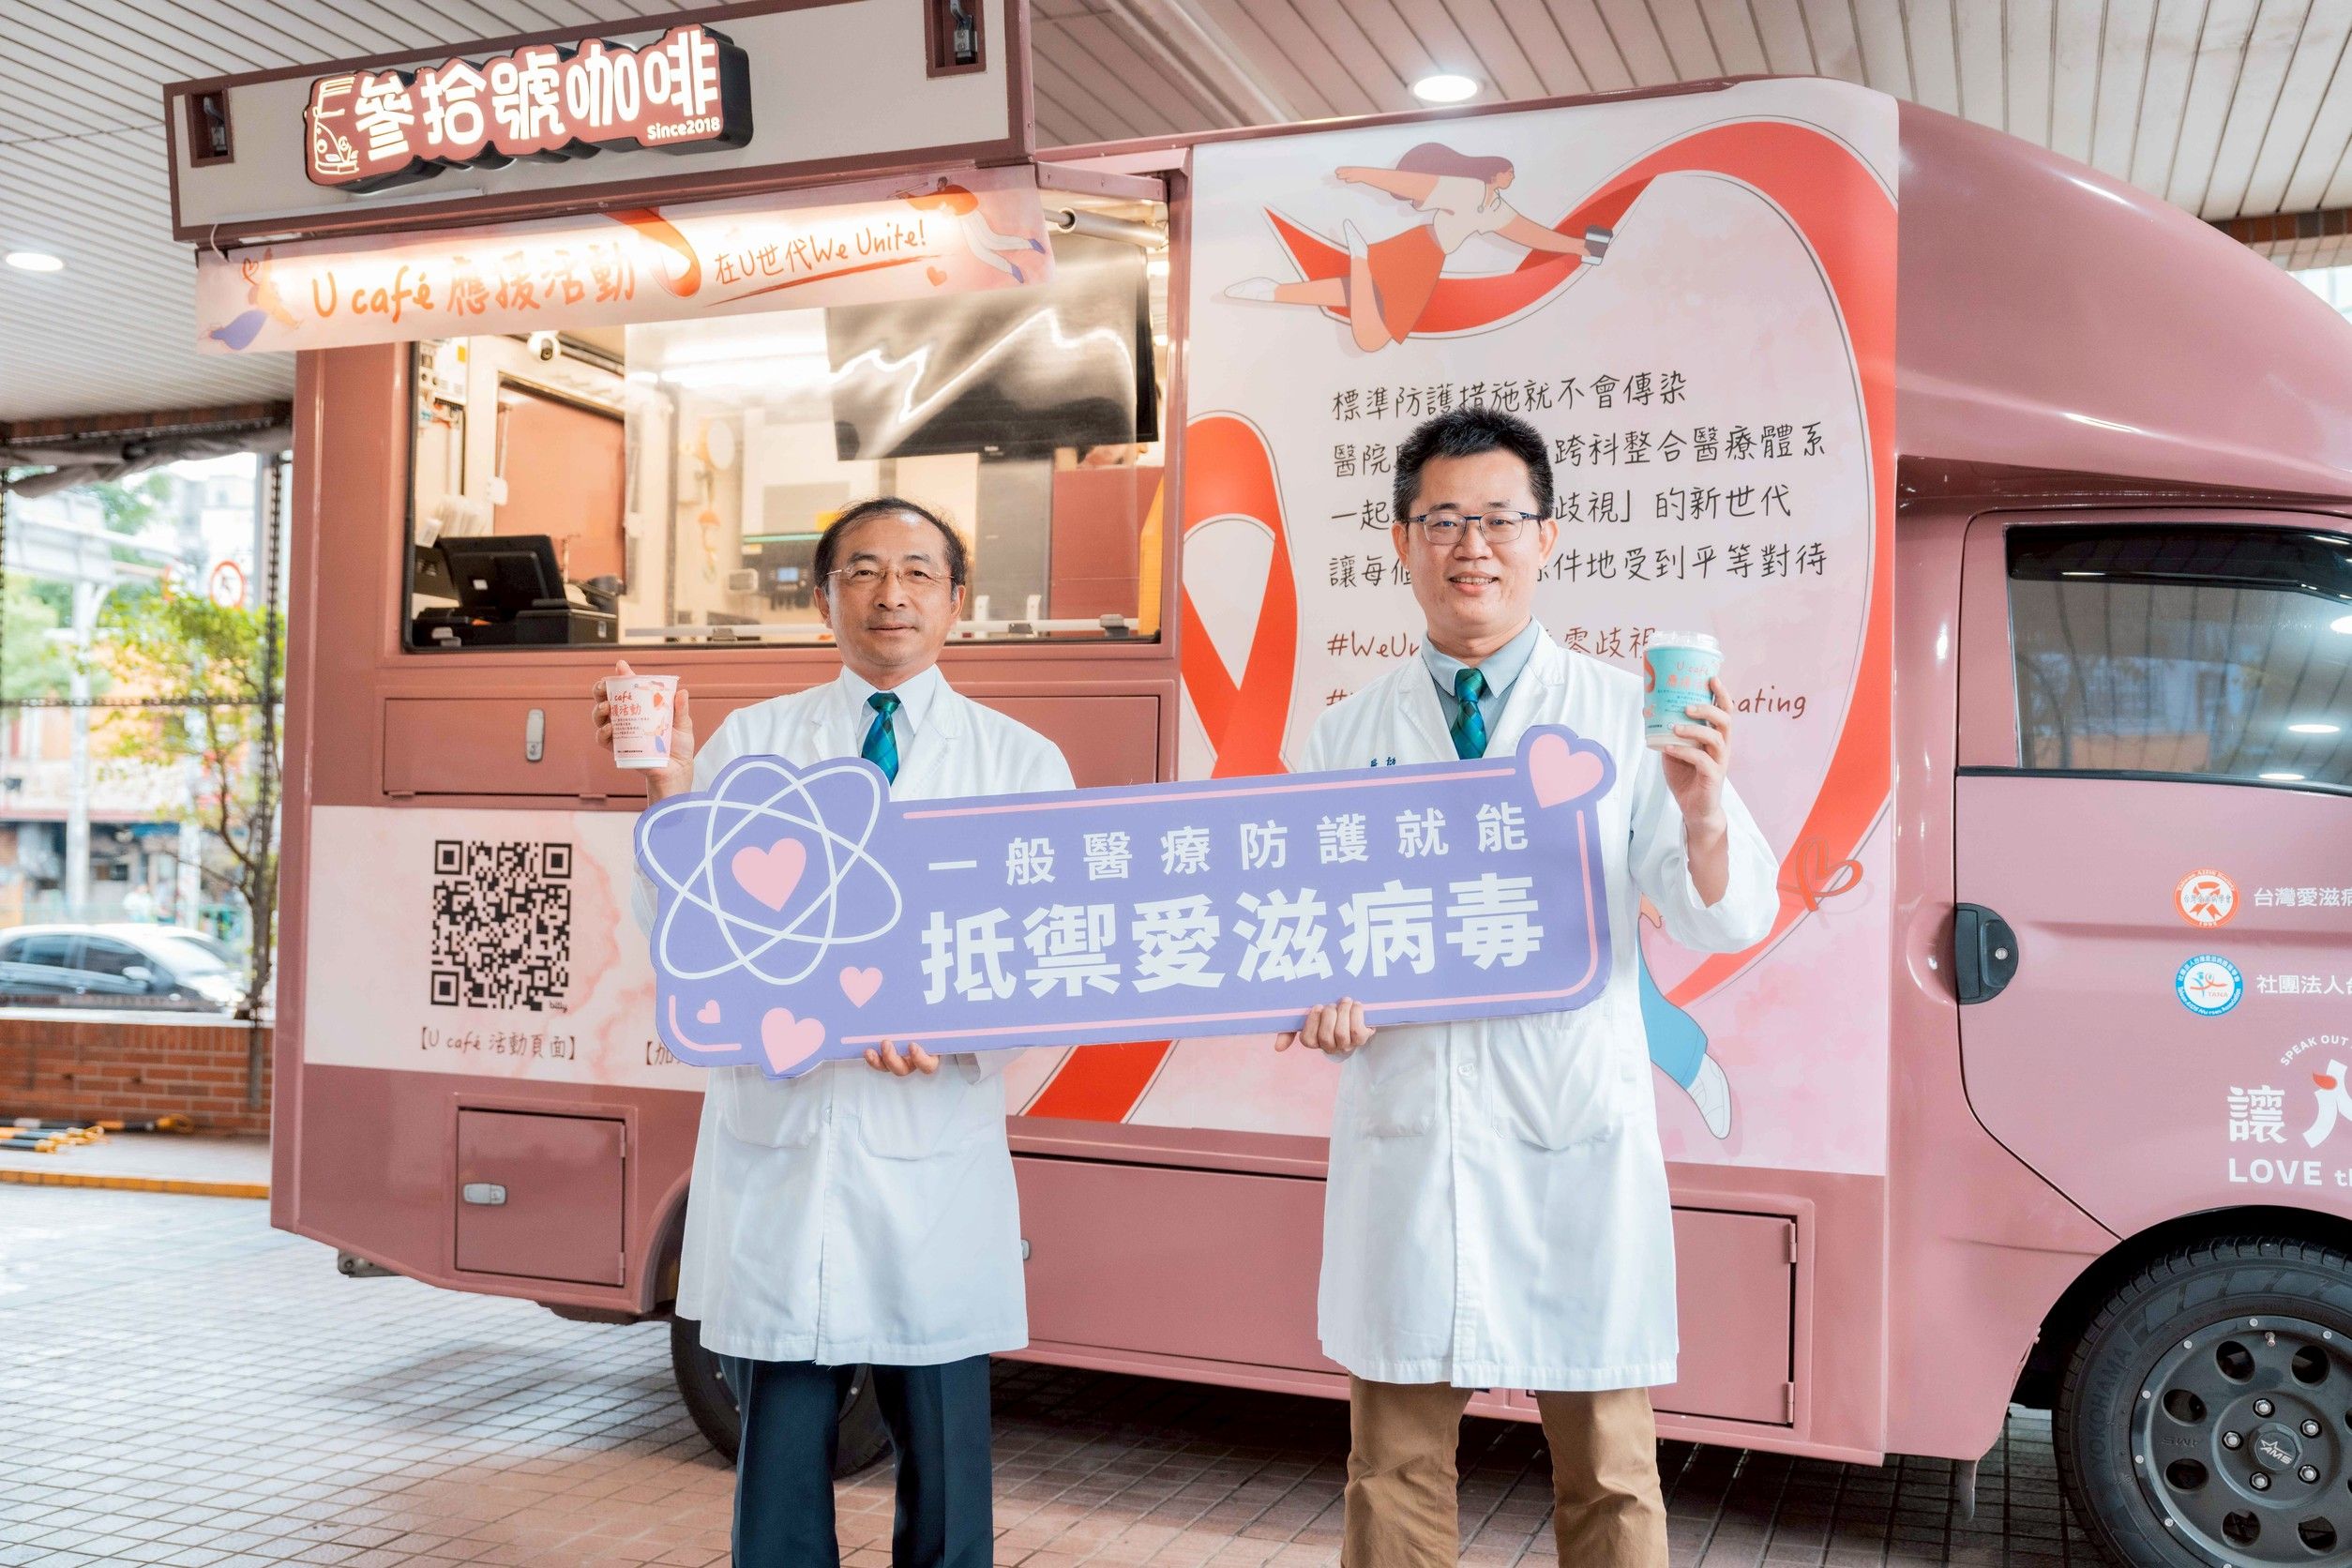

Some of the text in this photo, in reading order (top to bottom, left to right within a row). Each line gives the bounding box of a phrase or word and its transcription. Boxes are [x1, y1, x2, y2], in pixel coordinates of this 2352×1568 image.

[646, 115, 721, 141] Since2018
[855, 219, 927, 257] Unite!
[312, 271, 338, 317] U
[351, 264, 434, 324] café
[1331, 369, 1687, 422] 標準防護措施就不會傳染
[1731, 685, 1808, 720] ating
[928, 802, 1530, 885] 一般醫療防護就能
[921, 873, 1545, 1004] 抵禦愛滋病毒
[2280, 1034, 2349, 1066] SPEAK OUT
[2228, 1157, 2323, 1186] LOVE
